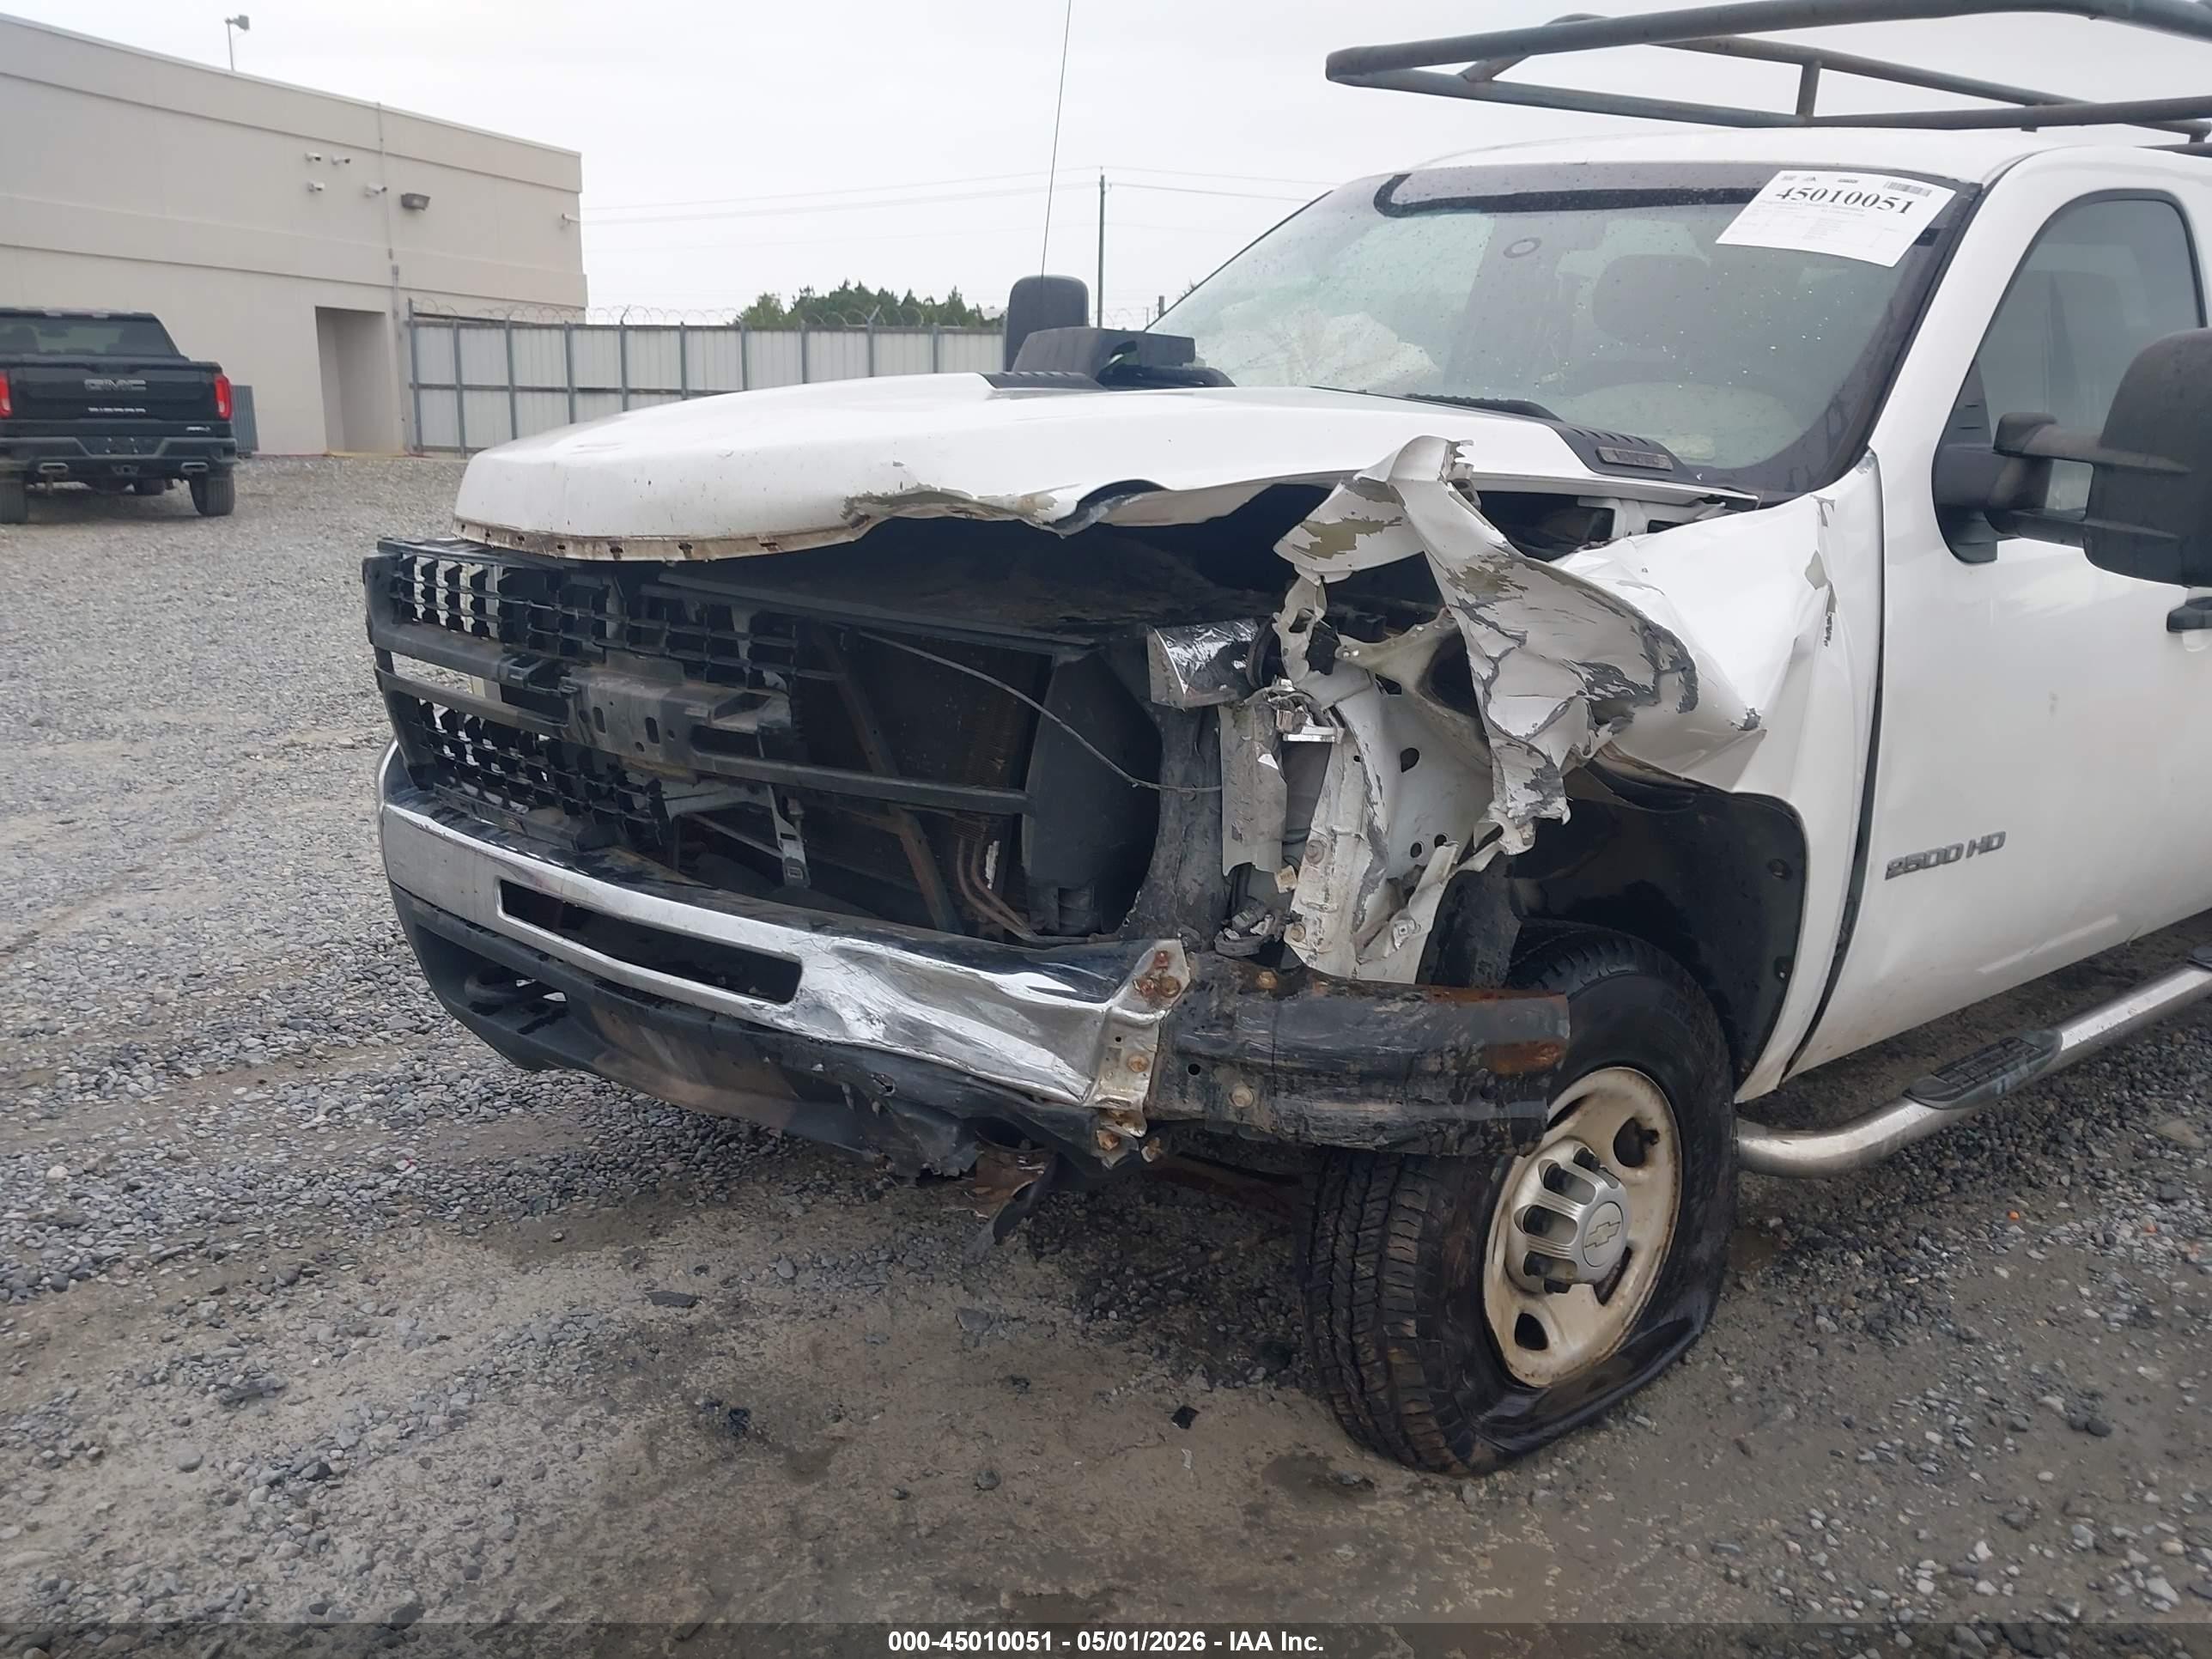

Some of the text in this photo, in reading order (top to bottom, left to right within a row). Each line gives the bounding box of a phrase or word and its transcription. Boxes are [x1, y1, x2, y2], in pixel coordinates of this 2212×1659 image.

[1776, 186, 1914, 214] 45010051
[1886, 831, 2006, 880] 2500 HD
